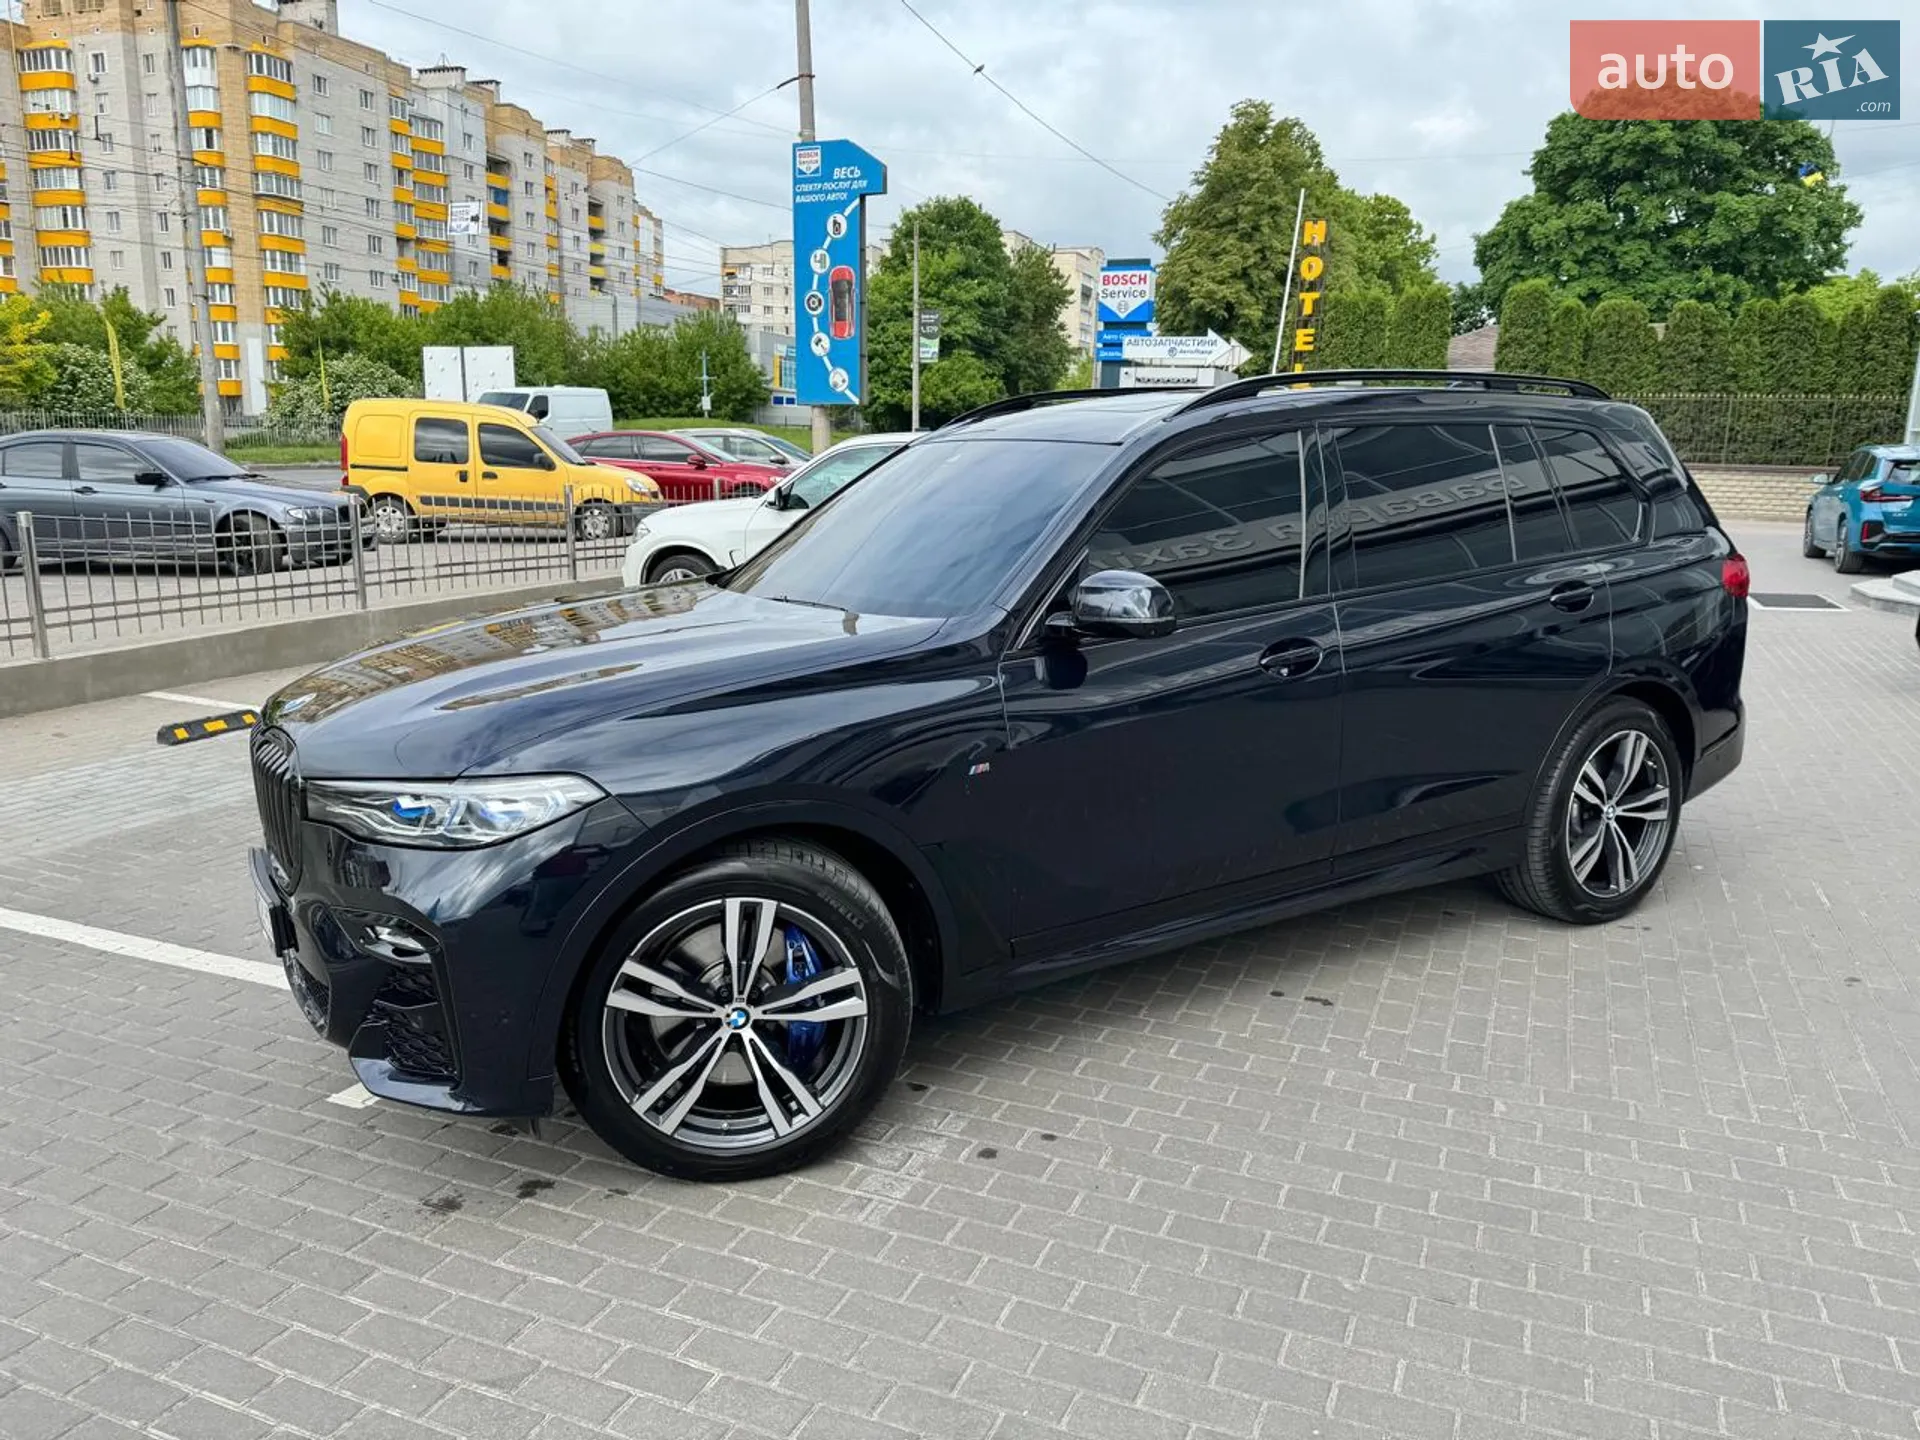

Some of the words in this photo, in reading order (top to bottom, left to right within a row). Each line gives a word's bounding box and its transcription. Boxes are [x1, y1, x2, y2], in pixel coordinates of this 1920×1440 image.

[833, 166, 861, 179] ВЕСЬ
[1102, 273, 1147, 286] BOSCH
[1101, 287, 1147, 299] Service
[1126, 338, 1218, 348] АВТОЗАПЧАСТИНИ
